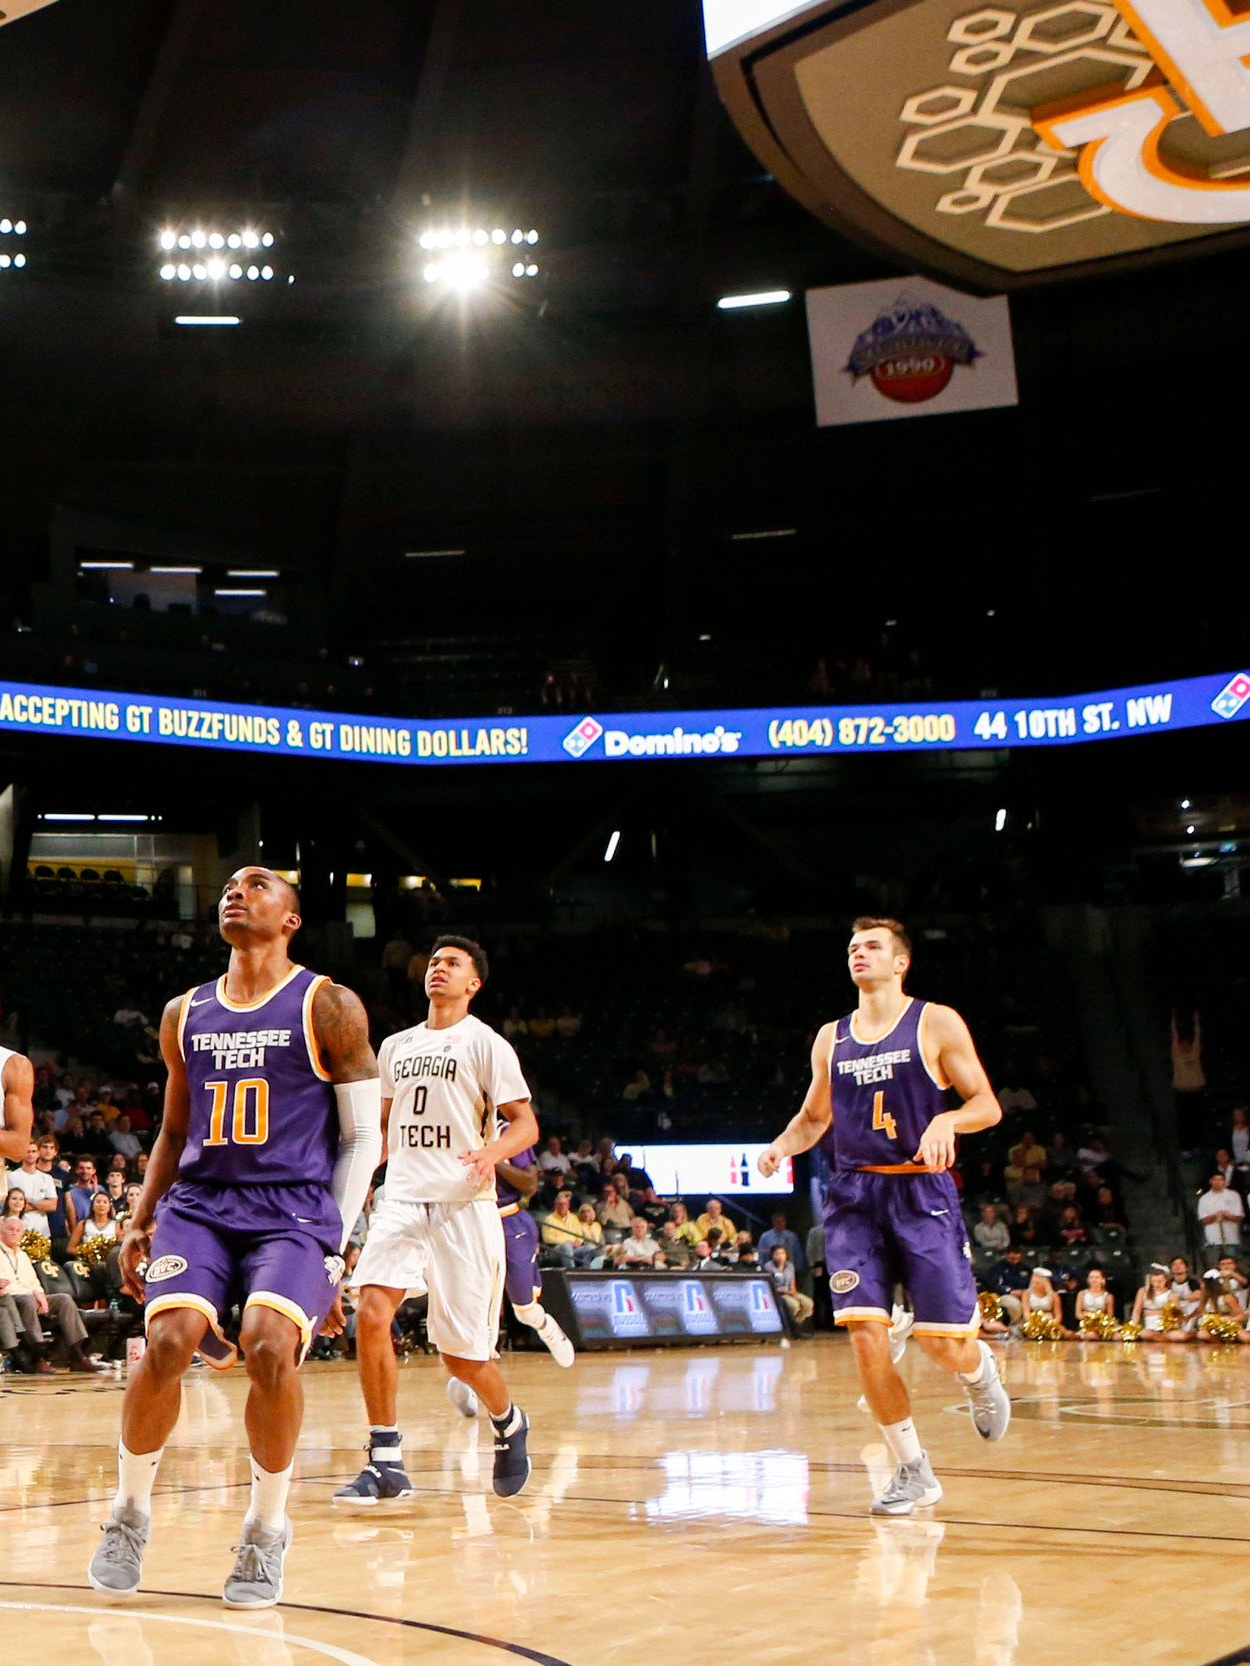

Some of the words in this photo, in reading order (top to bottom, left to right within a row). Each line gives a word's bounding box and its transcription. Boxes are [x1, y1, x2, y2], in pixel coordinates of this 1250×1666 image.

[885, 358, 935, 376] 1990
[126, 705, 153, 733] GT
[159, 707, 281, 746] BUZZFUNDS
[286, 719, 303, 747] &
[309, 722, 335, 750] GT
[340, 724, 412, 757] DINING
[417, 727, 529, 758] DOLLARS!
[768, 717, 833, 749] (404)
[839, 714, 955, 745] 872-3000
[974, 712, 1007, 741] 44
[1015, 707, 1077, 739] 10TH
[1083, 703, 1120, 734] ST.
[1127, 693, 1173, 728] NW
[604, 725, 742, 756] Domino's
[191, 1029, 292, 1051] TENNESSEE
[212, 1048, 265, 1070] TECH
[394, 1056, 457, 1082] GEORGIA
[837, 1049, 911, 1075] TENNESSEE
[853, 1064, 894, 1086] TECH
[203, 1078, 269, 1146] 10
[872, 1090, 897, 1139] 4
[400, 1125, 450, 1148] TECH
